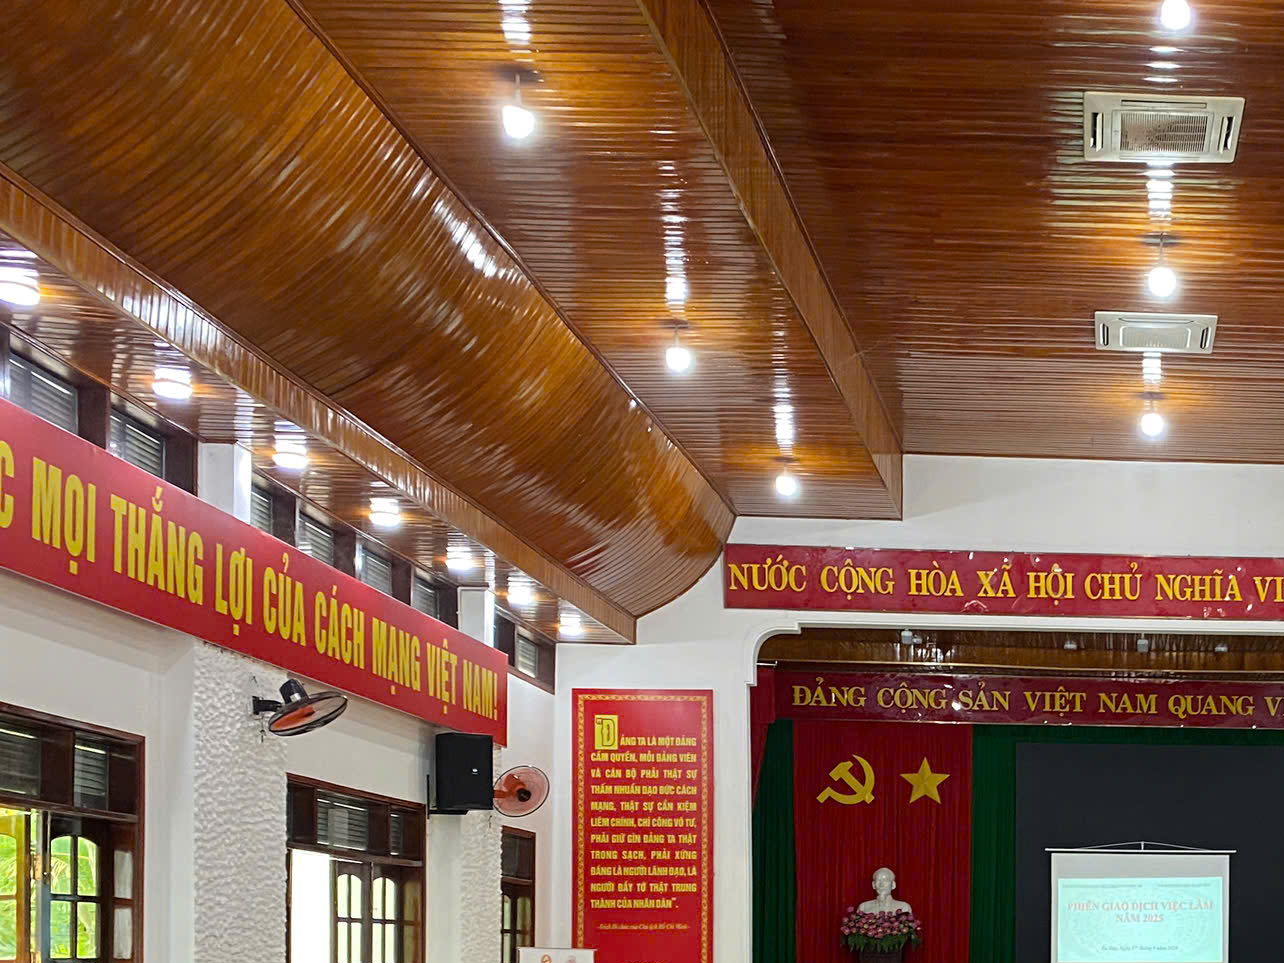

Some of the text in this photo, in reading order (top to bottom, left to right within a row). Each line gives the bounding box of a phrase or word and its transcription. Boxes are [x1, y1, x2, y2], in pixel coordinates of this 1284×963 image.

[32, 456, 96, 576] MỌI
[111, 486, 205, 605] THẮNG
[214, 542, 253, 638] LỢI
[262, 553, 306, 647] CỦA
[314, 586, 365, 667] CÁCH
[373, 615, 420, 697] MẠNG
[427, 640, 458, 716] VIỆT
[464, 657, 499, 720] NAM!
[728, 554, 807, 592] NƯỚC
[821, 558, 895, 600] CỘNG
[908, 561, 964, 597] HÒA
[977, 562, 1017, 599] XÃ
[1027, 563, 1075, 606] HỘI
[1084, 562, 1142, 601] CHỦ
[1155, 569, 1243, 602] NGHĨA
[792, 676, 866, 707] ĐẢNG
[877, 683, 946, 714] CỘNG
[962, 681, 1011, 712] SẢN
[1024, 687, 1087, 717] VIỆT
[1098, 692, 1158, 714] NAM
[1168, 694, 1256, 720] QUANG
[1142, 914, 1164, 923] 2025
